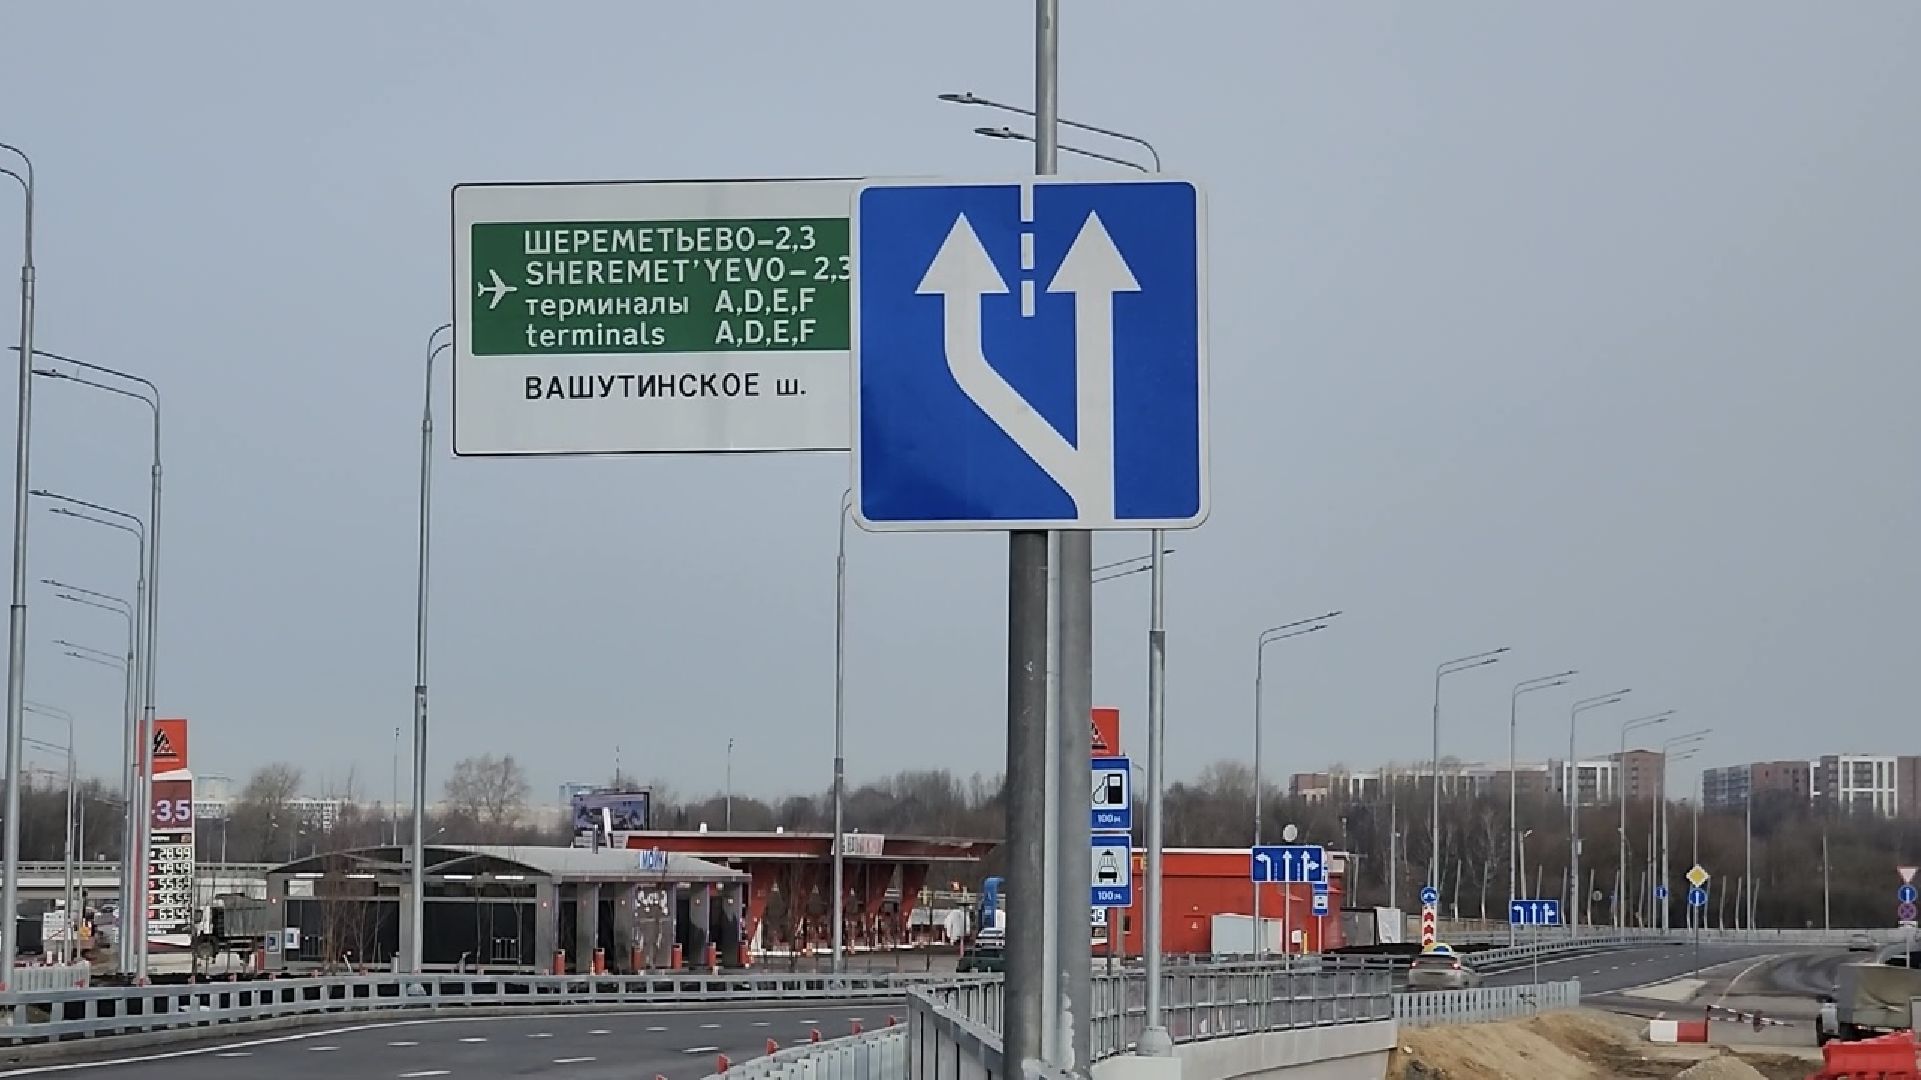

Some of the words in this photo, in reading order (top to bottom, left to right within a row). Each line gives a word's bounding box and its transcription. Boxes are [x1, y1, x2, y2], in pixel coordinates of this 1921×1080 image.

[525, 296, 689, 321] терминалы
[714, 287, 816, 316] A,D,E,F
[525, 320, 665, 347] terminals
[714, 319, 817, 347] A,D,E,F
[525, 372, 760, 400] ВАШУТИНСКОЕ
[776, 378, 807, 397] ш.
[1097, 890, 1113, 901] 100
